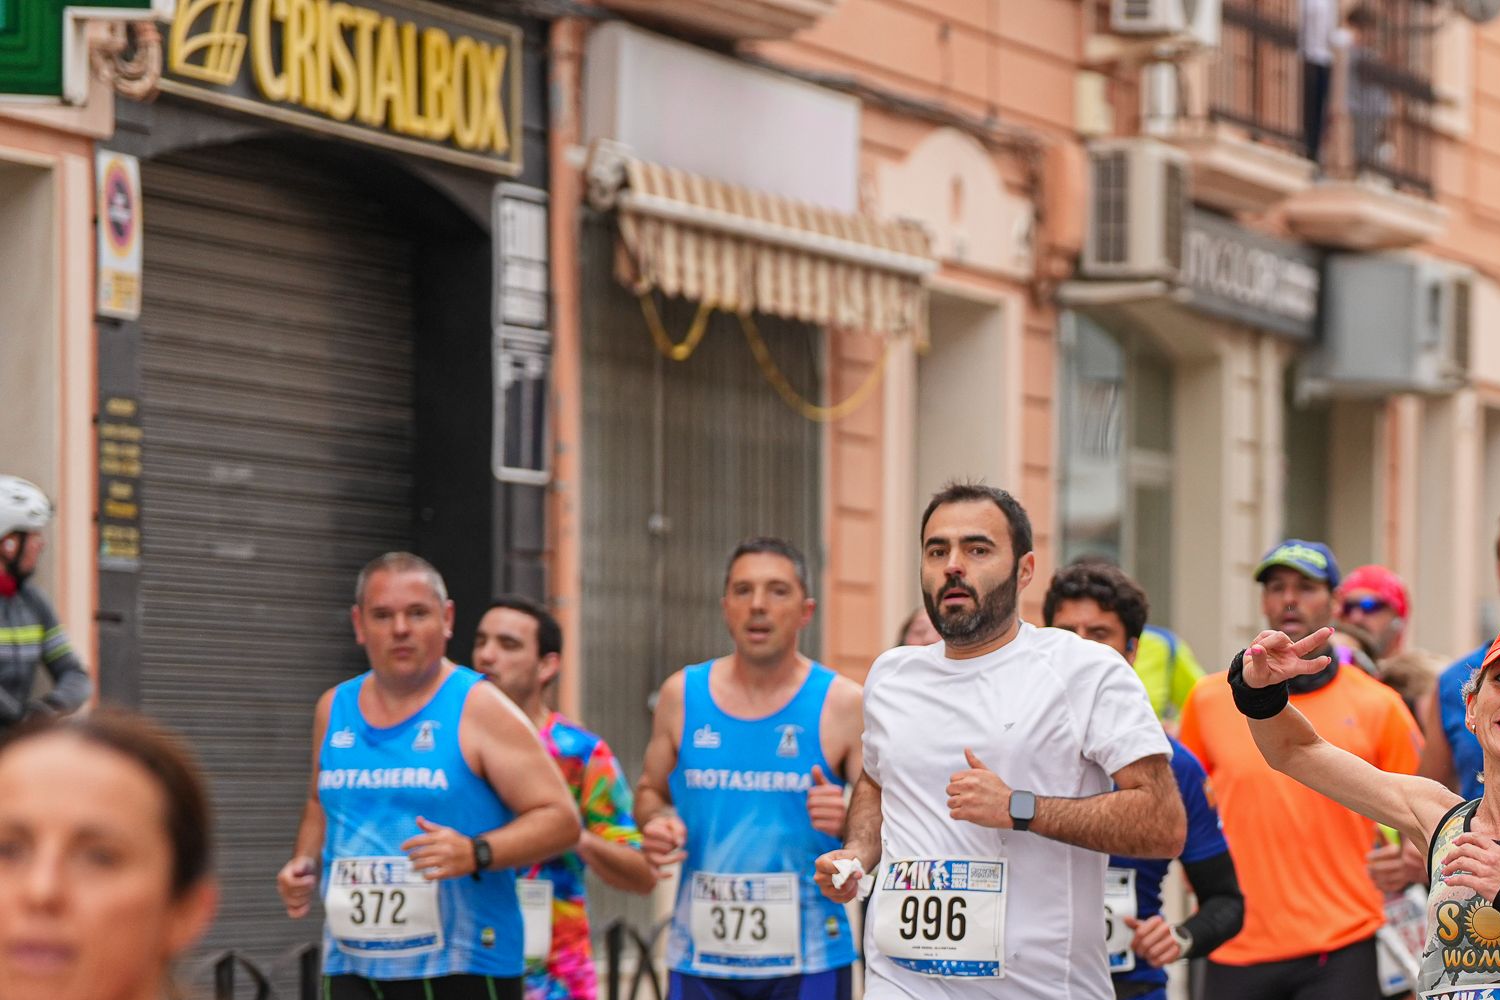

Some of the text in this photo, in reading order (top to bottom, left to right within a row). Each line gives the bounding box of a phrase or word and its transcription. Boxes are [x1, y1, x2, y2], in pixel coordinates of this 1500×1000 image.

[252, 0, 508, 155] CRISTALBOX
[894, 861, 932, 890] 21K
[350, 890, 406, 924] 372
[711, 906, 767, 941] 373
[899, 895, 967, 941] 996
